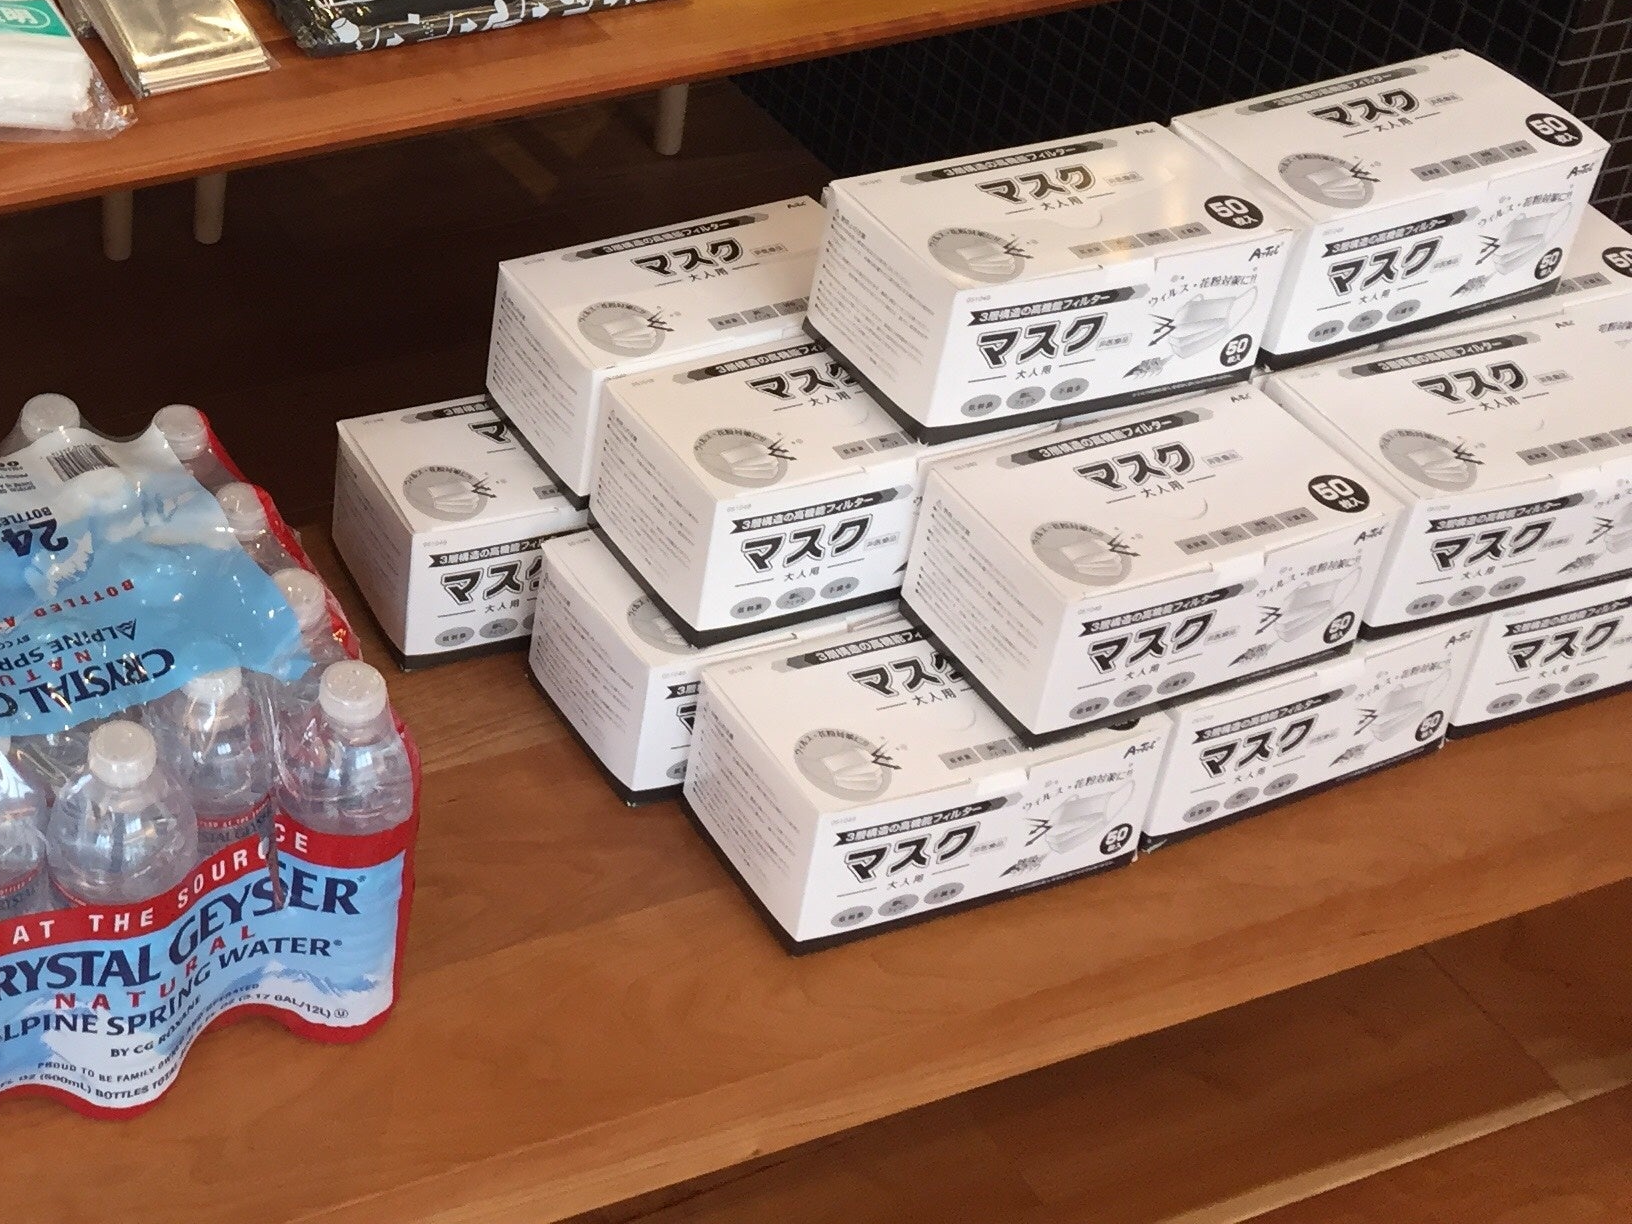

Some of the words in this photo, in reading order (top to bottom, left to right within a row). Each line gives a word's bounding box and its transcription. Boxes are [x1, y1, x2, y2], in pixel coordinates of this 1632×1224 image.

[1308, 88, 1419, 129] マスク
[1376, 117, 1415, 133] 大人用
[1528, 116, 1567, 135] 50
[976, 164, 1096, 205] マスク
[1041, 196, 1084, 212] 大人用
[1208, 198, 1248, 217] 50
[631, 236, 744, 277] マスク
[689, 267, 729, 282] 大人用
[1327, 236, 1443, 296] マスク
[978, 312, 1108, 369] マスク
[1225, 338, 1248, 356] 50
[1015, 365, 1052, 380] 大人用
[1412, 360, 1529, 404] マスク
[808, 391, 851, 407] 大人用
[1479, 396, 1520, 411] 大人用
[1072, 441, 1195, 491] マスク
[1141, 480, 1185, 499] 大人用
[1311, 477, 1356, 502] 50
[0, 518, 69, 558] 24
[741, 513, 873, 573] マスク
[1430, 517, 1556, 572] マスク
[784, 567, 820, 581] 大人用
[33, 579, 135, 618] BOTTLED
[484, 599, 520, 614] 大人用
[50, 618, 139, 656] ALPINE
[1087, 609, 1217, 674] マスク
[1507, 616, 1624, 672] マスク
[22, 648, 175, 715] CRYSTAL
[912, 688, 956, 706] 大人用
[1200, 714, 1318, 778] マスク
[844, 820, 982, 884] マスク
[10, 920, 57, 947] AT
[88, 906, 154, 935] THE
[177, 826, 310, 910] SOURCE
[887, 874, 924, 890] 大人用
[168, 862, 362, 965] GEYSER
[54, 924, 256, 1013] NATURAL
[105, 960, 212, 1038] SPRING
[217, 936, 331, 970] WATER
[110, 1047, 129, 1058] BY
[133, 1041, 154, 1055] CG
[95, 1084, 149, 1101] BOTTLES
[116, 1066, 155, 1082] FAMILY
